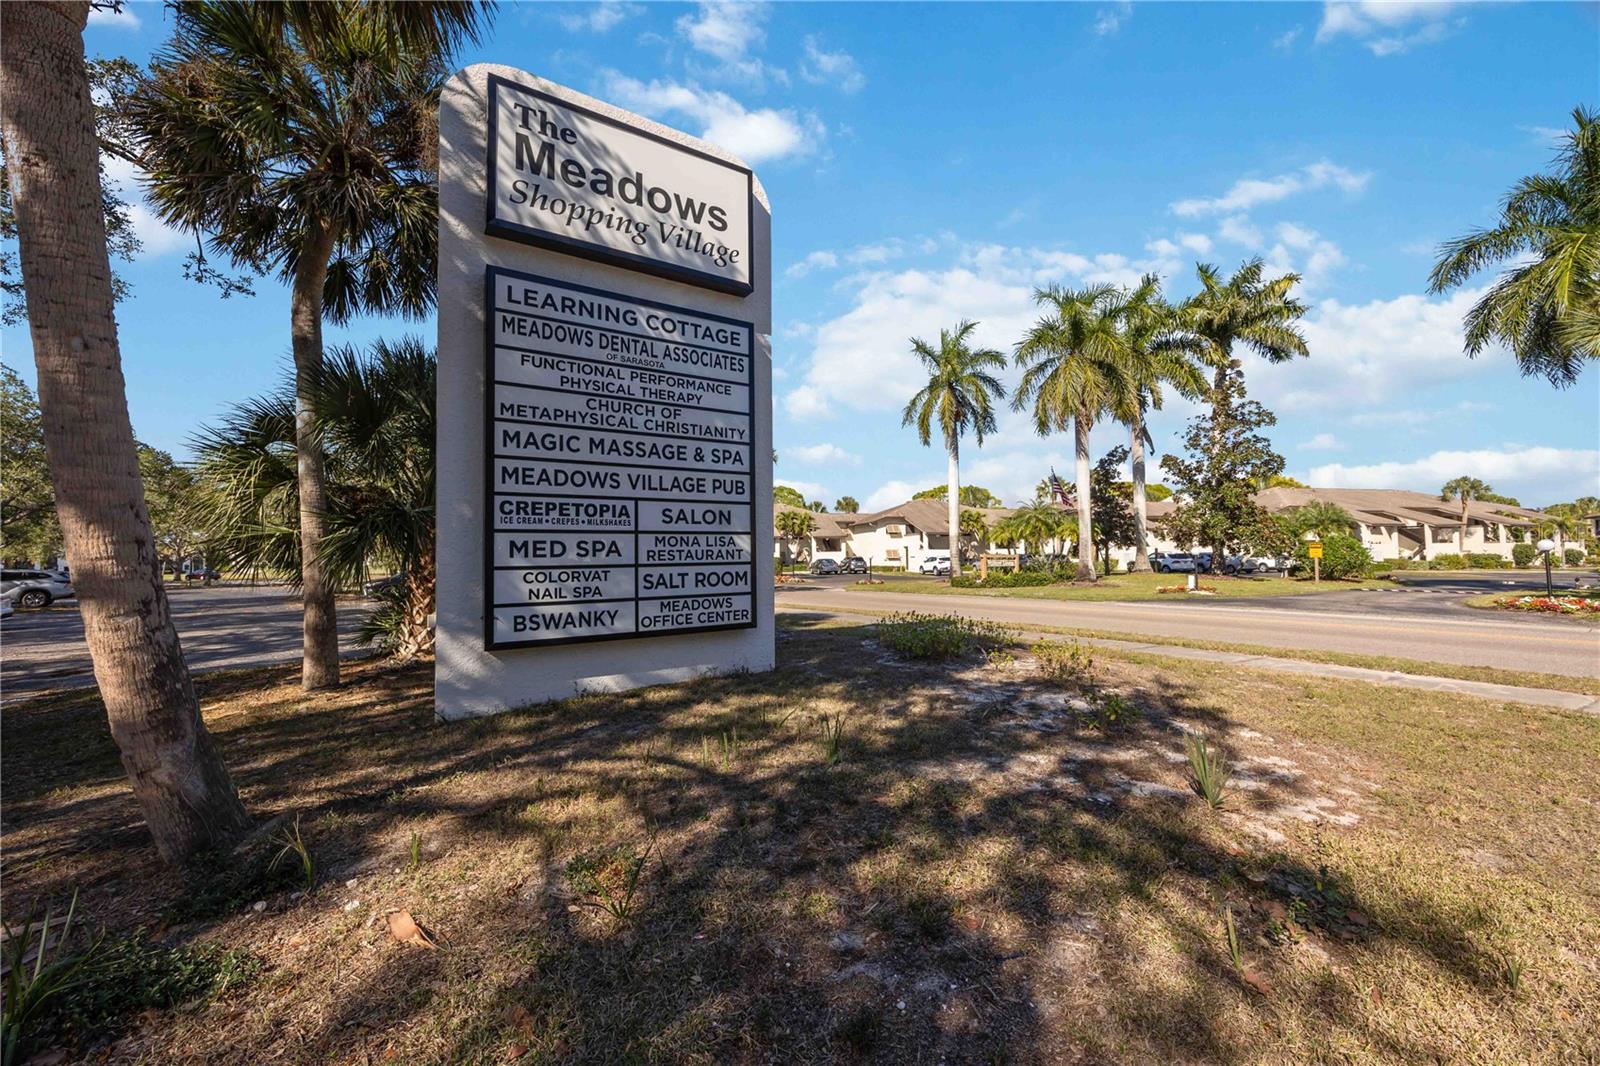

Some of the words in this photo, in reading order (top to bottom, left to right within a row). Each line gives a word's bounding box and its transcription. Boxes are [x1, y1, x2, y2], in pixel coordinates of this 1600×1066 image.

[514, 102, 577, 145] The
[515, 132, 728, 232] Meadows
[509, 179, 650, 245] Shopping
[657, 220, 740, 267] Village
[507, 285, 638, 326] LEARNING
[645, 314, 741, 347] COTTAGE
[502, 315, 593, 347] MEADOWS
[599, 334, 659, 358] DENTAL
[663, 345, 745, 373] ASSOCIATES
[621, 355, 665, 368] SARASOTA
[521, 354, 625, 381] FUNCTIONAL
[630, 371, 732, 395] PERFORMANCE
[560, 376, 635, 396] PHYSICAL
[640, 386, 703, 405] THERAPY
[586, 398, 656, 418] CHURCH
[661, 407, 682, 420] OF
[499, 402, 639, 430] METAPHYSICAL
[644, 420, 746, 440] CHRISTIANITY
[502, 429, 580, 452] MAGIC
[589, 437, 687, 461] MASSAGE
[693, 448, 706, 462] &
[711, 449, 744, 466] SPA
[501, 466, 621, 490] MEADOWS
[628, 473, 706, 494] VILLAGE
[713, 480, 746, 495] PUB
[499, 500, 631, 518] CREPETOPIA
[662, 508, 732, 525] SALON
[500, 516, 514, 525] ICE
[516, 517, 543, 525] CREAM
[551, 517, 580, 526] CREPES
[586, 518, 632, 527] MILKSHAKES
[509, 540, 567, 559] MED
[576, 540, 622, 558] SPA
[654, 535, 700, 548] MONA
[706, 535, 737, 548] LISA
[646, 549, 744, 562] RESTAURANT
[523, 570, 611, 584] COLORVAT
[642, 572, 689, 590] SALT
[695, 570, 748, 588] ROOM
[528, 587, 567, 600] NAIL
[573, 586, 603, 599] SPA
[660, 598, 733, 613] MEADOWS
[513, 609, 619, 632] BSWANKY
[640, 613, 693, 629] OFFICE
[698, 609, 750, 624] CENTER
